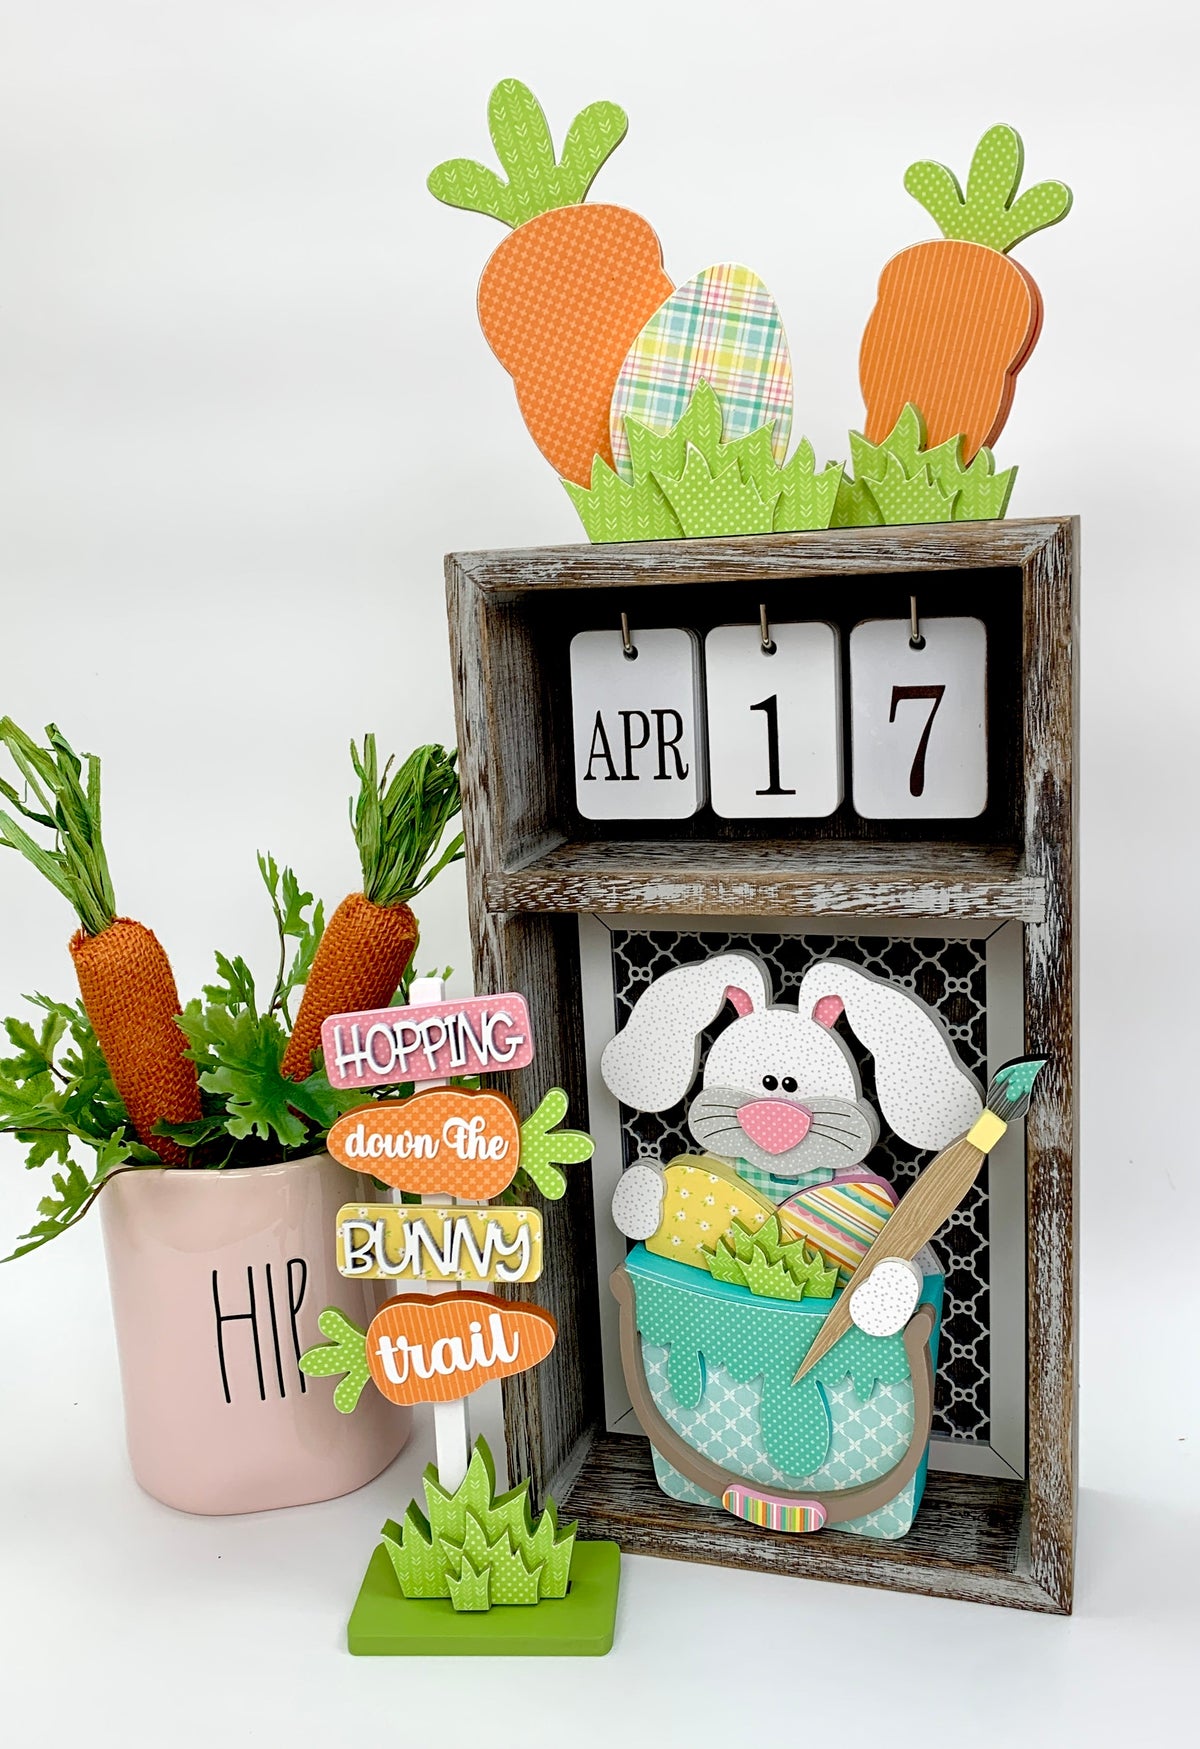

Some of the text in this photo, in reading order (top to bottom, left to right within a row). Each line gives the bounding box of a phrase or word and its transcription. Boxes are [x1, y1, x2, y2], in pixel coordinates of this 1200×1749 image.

[583, 684, 946, 798] APR 1 7
[333, 1009, 524, 1079] HOPPING
[344, 1114, 509, 1161] down the
[340, 1216, 531, 1282] BUNNY
[212, 1258, 308, 1404] HIP
[375, 1312, 519, 1385] trail
